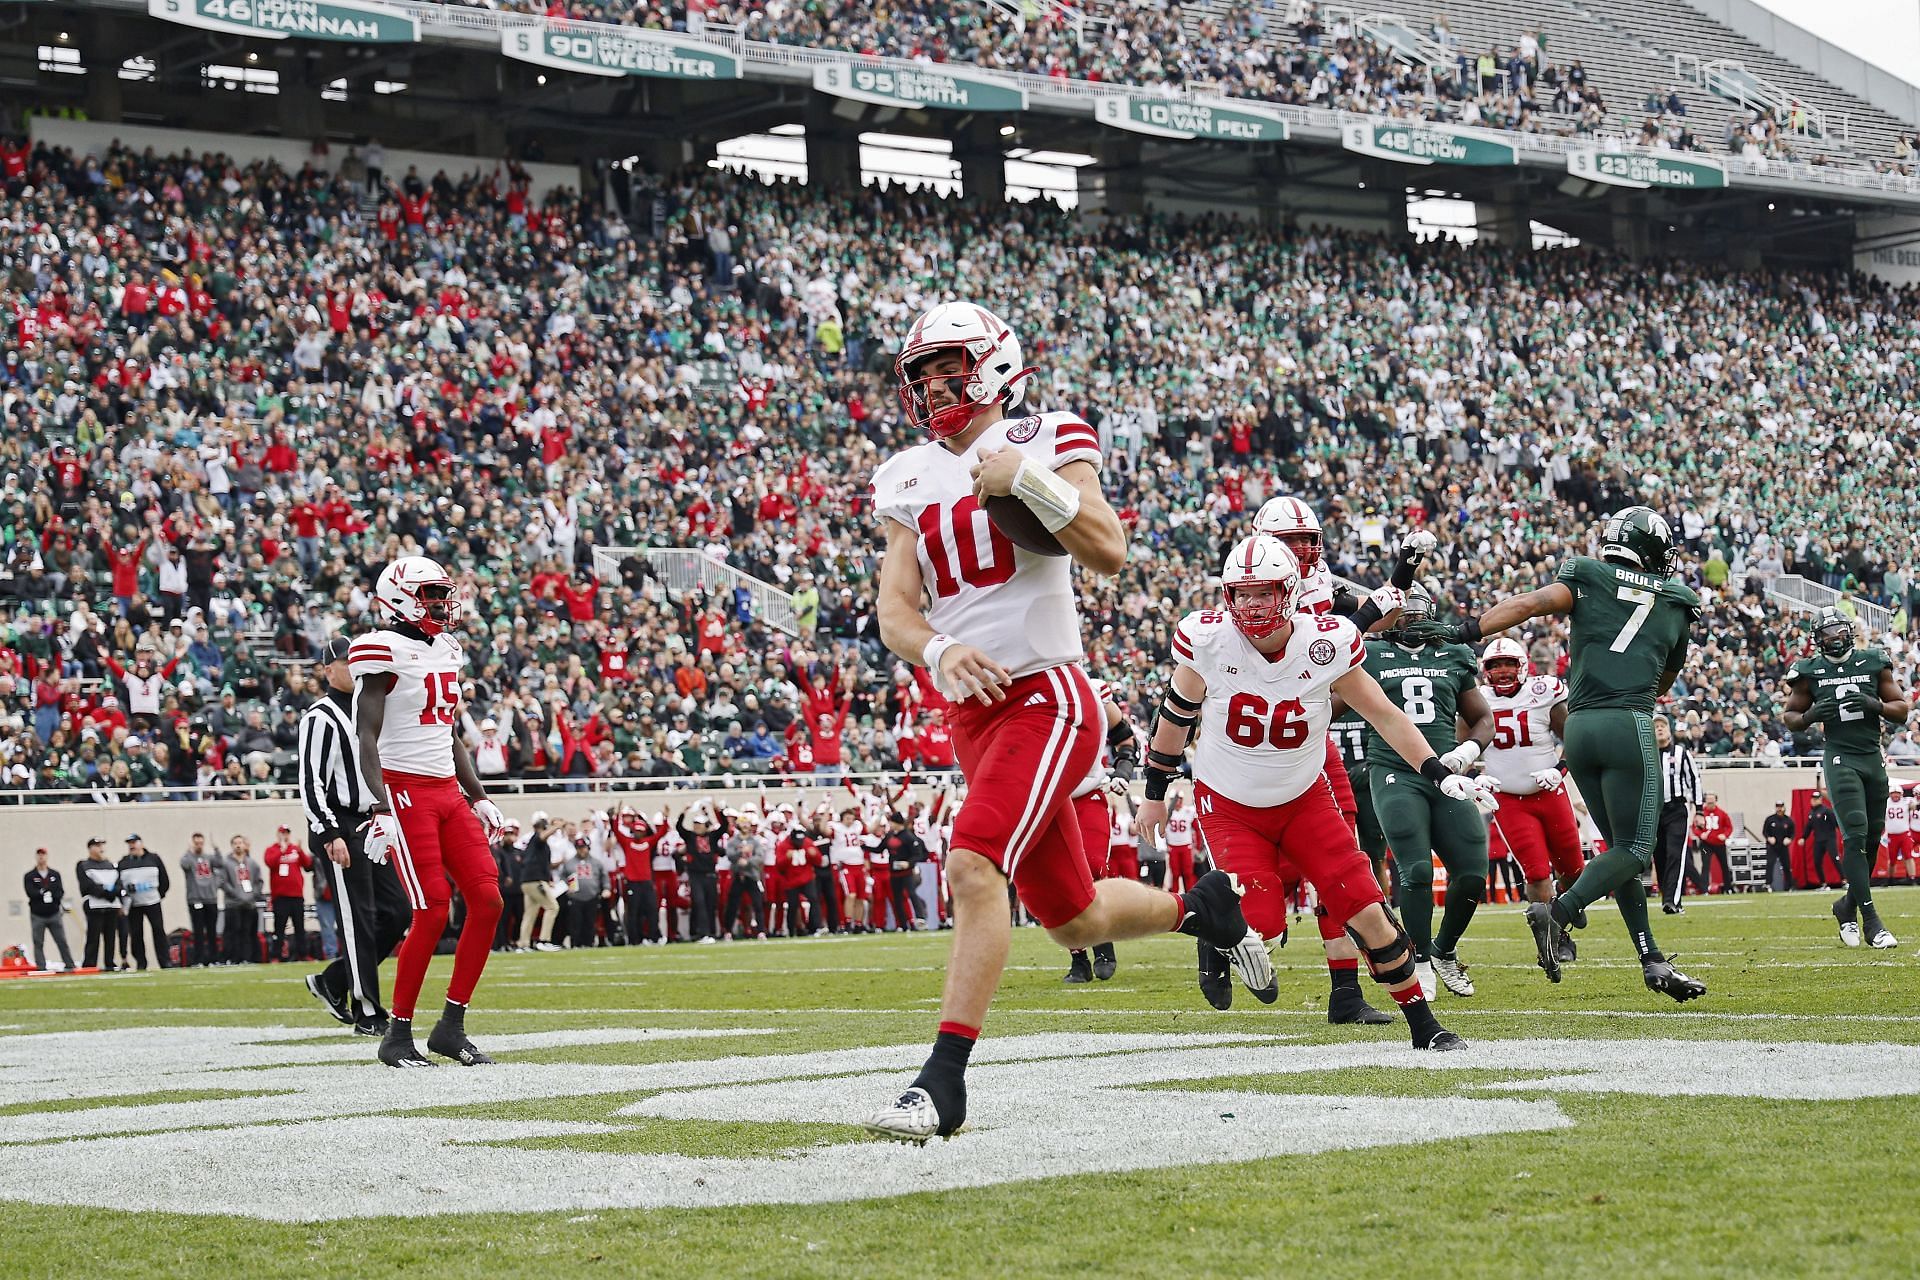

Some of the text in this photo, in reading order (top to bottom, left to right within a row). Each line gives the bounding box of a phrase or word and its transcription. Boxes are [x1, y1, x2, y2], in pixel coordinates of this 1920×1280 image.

[203, 0, 252, 20] 46
[256, 0, 317, 16] JOHN
[257, 11, 379, 40] HANNAH
[550, 36, 593, 59] 90
[598, 50, 716, 78] WEBSTER
[856, 71, 894, 92] 95
[899, 84, 968, 105] SMITH
[1139, 103, 1169, 124] 10
[1171, 115, 1263, 139] VAN PELT
[1378, 131, 1409, 150] 48
[1413, 140, 1467, 160] SNOW
[1600, 156, 1628, 175] 23
[1630, 166, 1695, 186] GIBSON
[917, 495, 1017, 599] 10
[389, 563, 408, 587] N
[1616, 568, 1663, 592] BRULE
[1608, 585, 1655, 653] 7
[1380, 667, 1448, 680] MICHIGAN STATE
[419, 671, 459, 726] 15
[1401, 676, 1436, 724] 8
[1225, 692, 1310, 750] 66
[1493, 709, 1534, 750] 51
[395, 789, 413, 810] N
[1200, 794, 1213, 815] N
